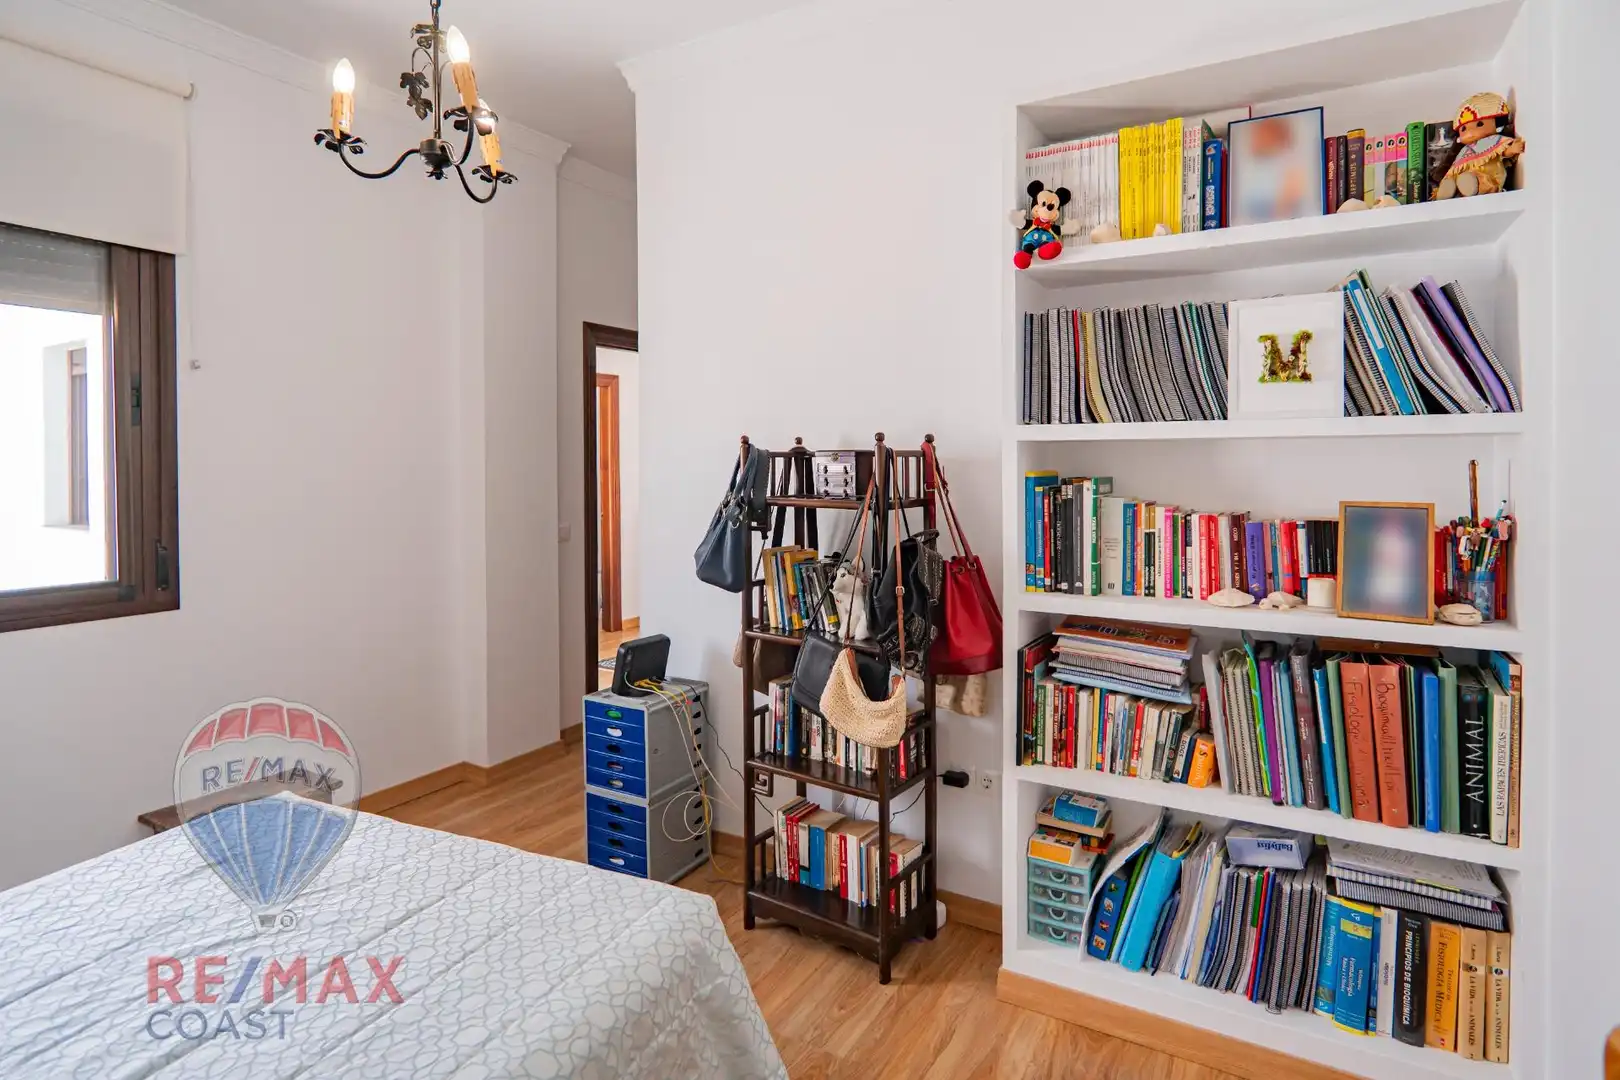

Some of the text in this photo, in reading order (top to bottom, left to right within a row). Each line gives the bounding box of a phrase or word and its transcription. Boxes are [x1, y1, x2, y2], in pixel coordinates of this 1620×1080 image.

[1257, 329, 1314, 384] M
[1179, 740, 1187, 757] DOGS
[1464, 715, 1484, 803] ANIMAL
[1404, 930, 1413, 970] PRINCIPIOS
[1404, 971, 1412, 983] DE
